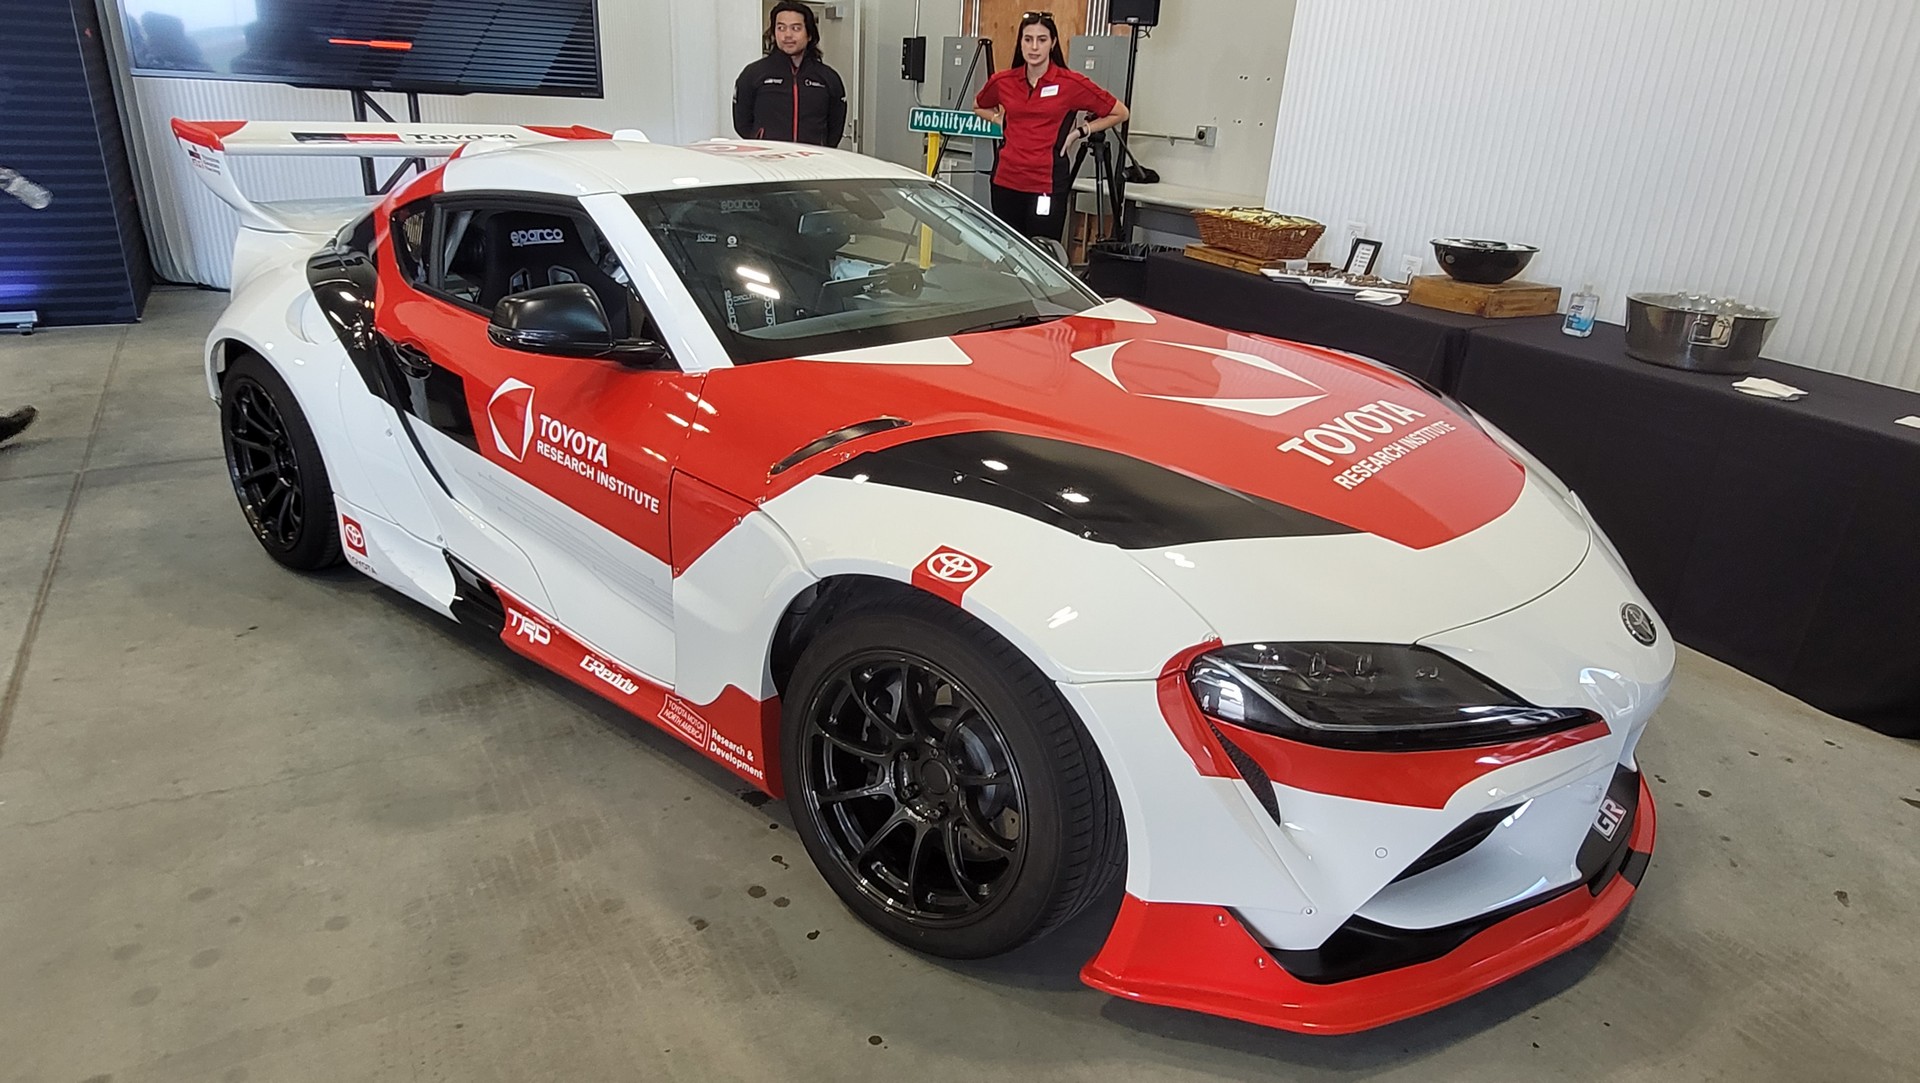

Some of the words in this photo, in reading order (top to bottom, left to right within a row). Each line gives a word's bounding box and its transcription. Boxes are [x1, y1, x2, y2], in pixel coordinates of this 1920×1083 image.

[913, 111, 992, 134] Mobility4All
[540, 414, 608, 468] TOYOTA
[1276, 400, 1426, 466] TOYOTA
[1333, 441, 1410, 490] RESEARCH
[1400, 420, 1456, 450] INSTITUTE
[537, 440, 594, 480] RESEARCH
[597, 470, 660, 514] INSTITUTE
[508, 607, 551, 645] TRD
[580, 655, 639, 695] GReddy
[664, 709, 682, 726] NORTH
[680, 721, 703, 741] AMERICA
[668, 700, 688, 719] TOYOTA
[687, 713, 705, 732] MOTOR
[710, 741, 763, 780] Development
[712, 729, 745, 757] Research
[747, 750, 754, 762] &
[1593, 799, 1624, 837] GR
